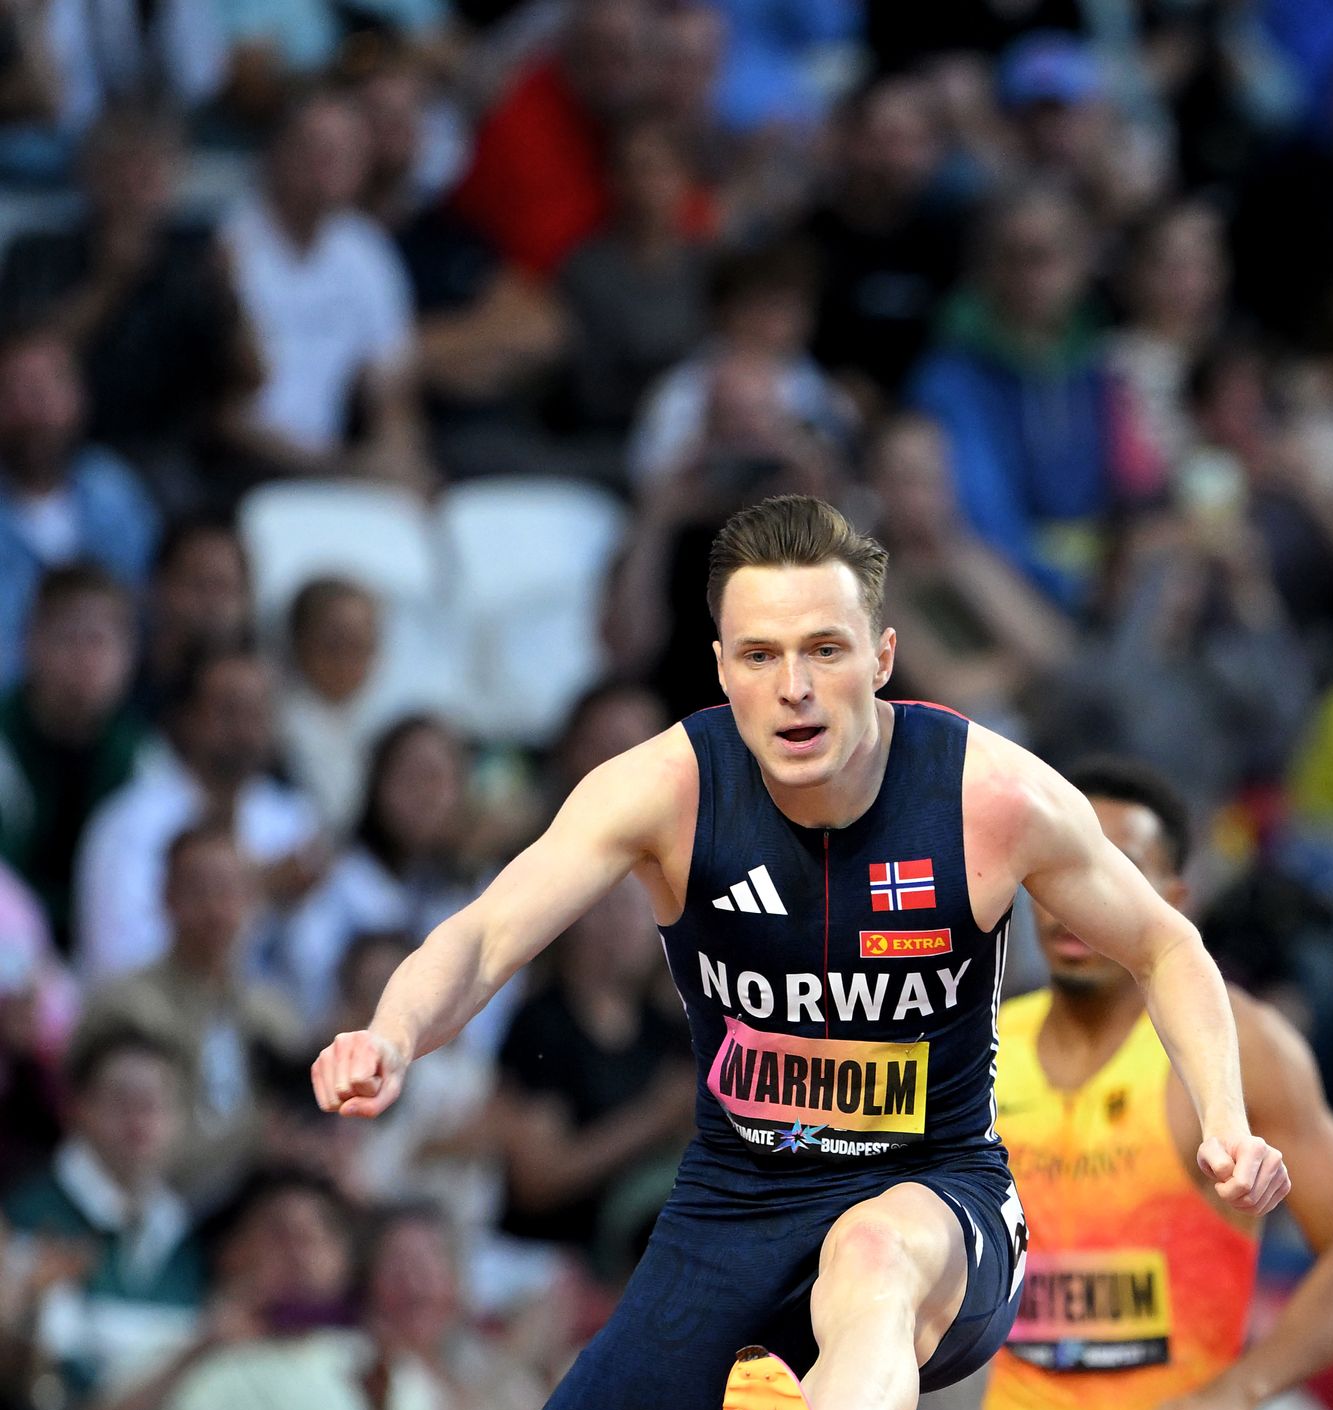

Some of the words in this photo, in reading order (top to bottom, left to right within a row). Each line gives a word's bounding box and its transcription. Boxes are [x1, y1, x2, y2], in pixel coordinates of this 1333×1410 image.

[892, 937, 946, 950] EXTRA
[698, 951, 972, 1022] NORWAY
[718, 1037, 917, 1116] WARHOLM
[820, 1138, 890, 1157] BUDAPEST
